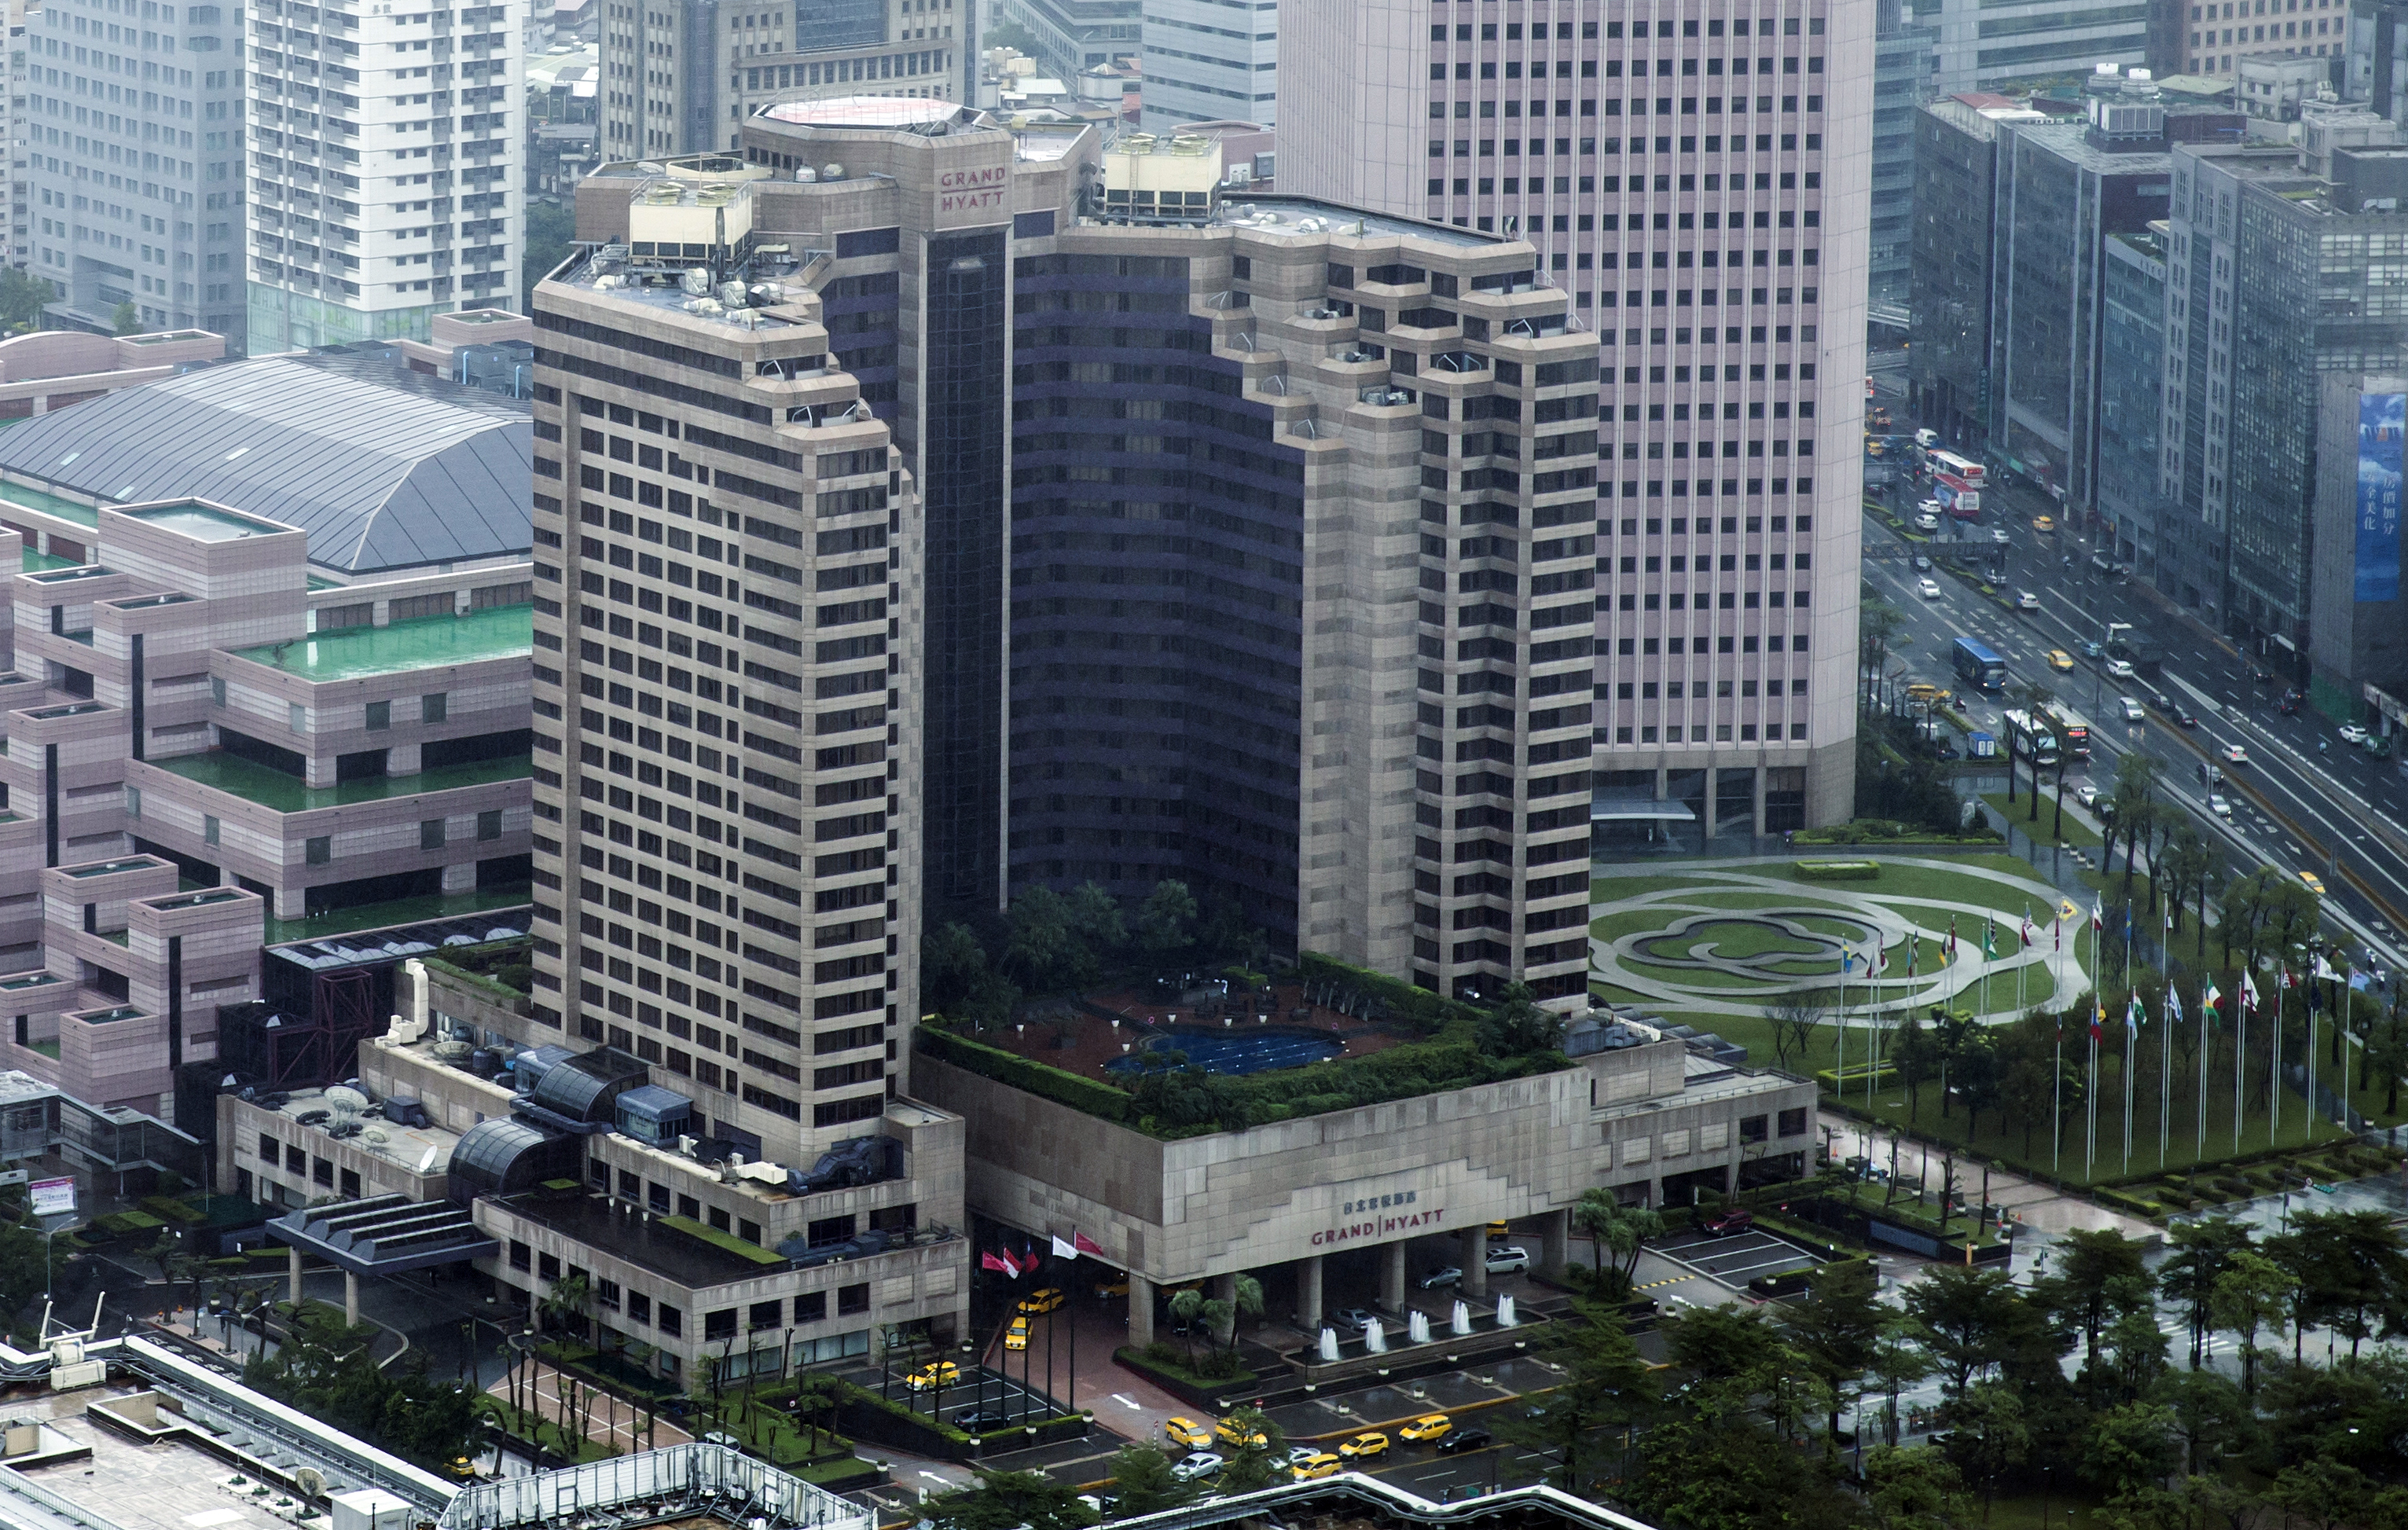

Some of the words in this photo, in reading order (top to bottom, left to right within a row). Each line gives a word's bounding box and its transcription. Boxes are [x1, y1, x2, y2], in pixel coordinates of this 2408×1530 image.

[941, 167, 1006, 186] GRAND
[942, 192, 1004, 211] HYATT
[1312, 1222, 1375, 1246] GRAND
[1385, 1209, 1444, 1231] HYATT
